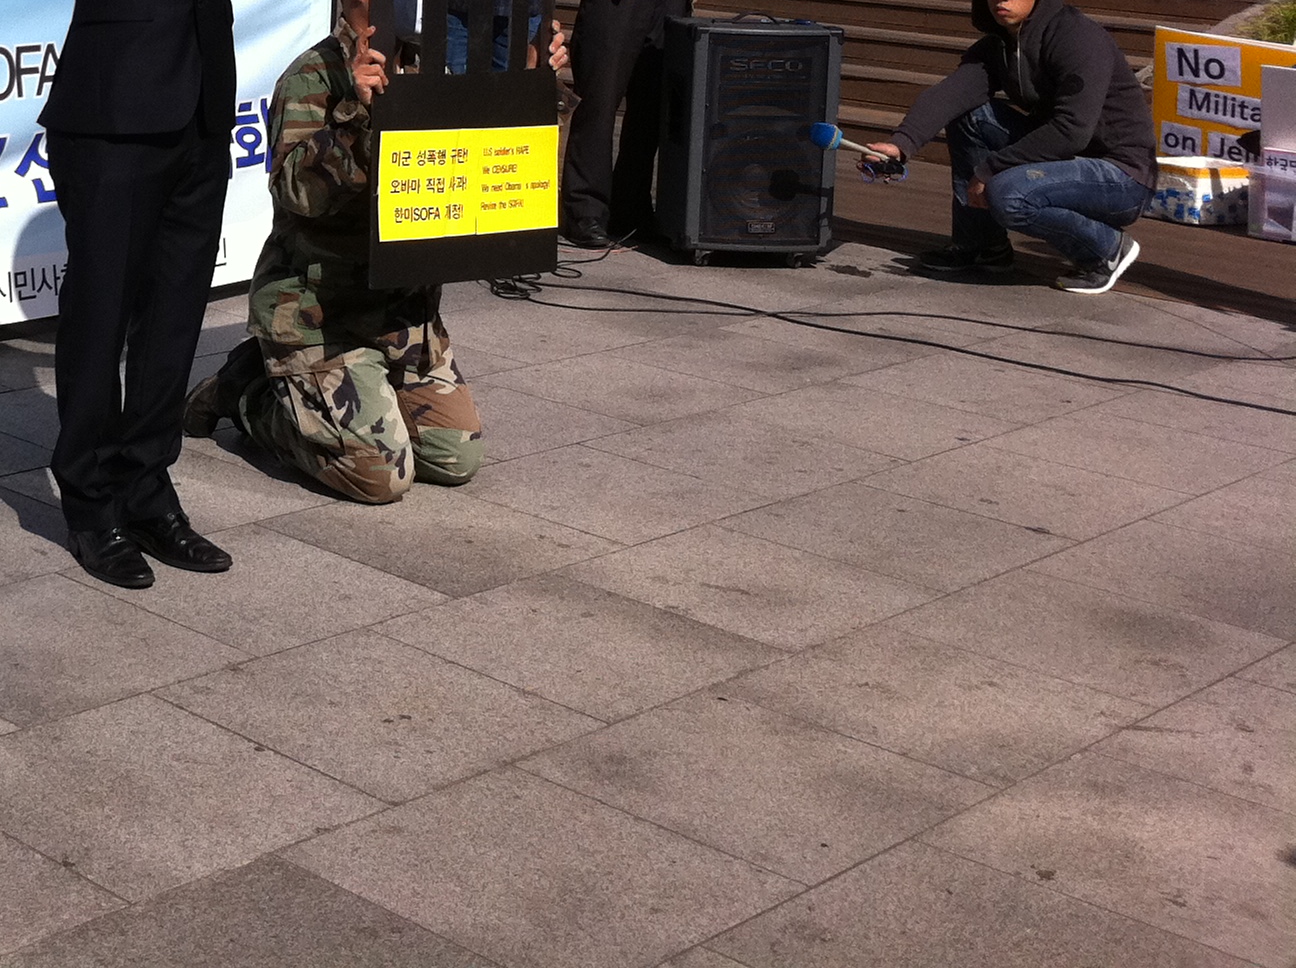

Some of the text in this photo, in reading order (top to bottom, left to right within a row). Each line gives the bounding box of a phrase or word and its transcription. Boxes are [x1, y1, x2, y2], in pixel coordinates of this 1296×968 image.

[1177, 47, 1226, 80] No
[1164, 132, 1197, 153] on
[391, 150, 412, 166] 미군
[416, 149, 447, 166] 성폭행
[390, 178, 421, 194] 오바마
[425, 177, 446, 193] 직접
[394, 206, 441, 223] 한미SOFA
